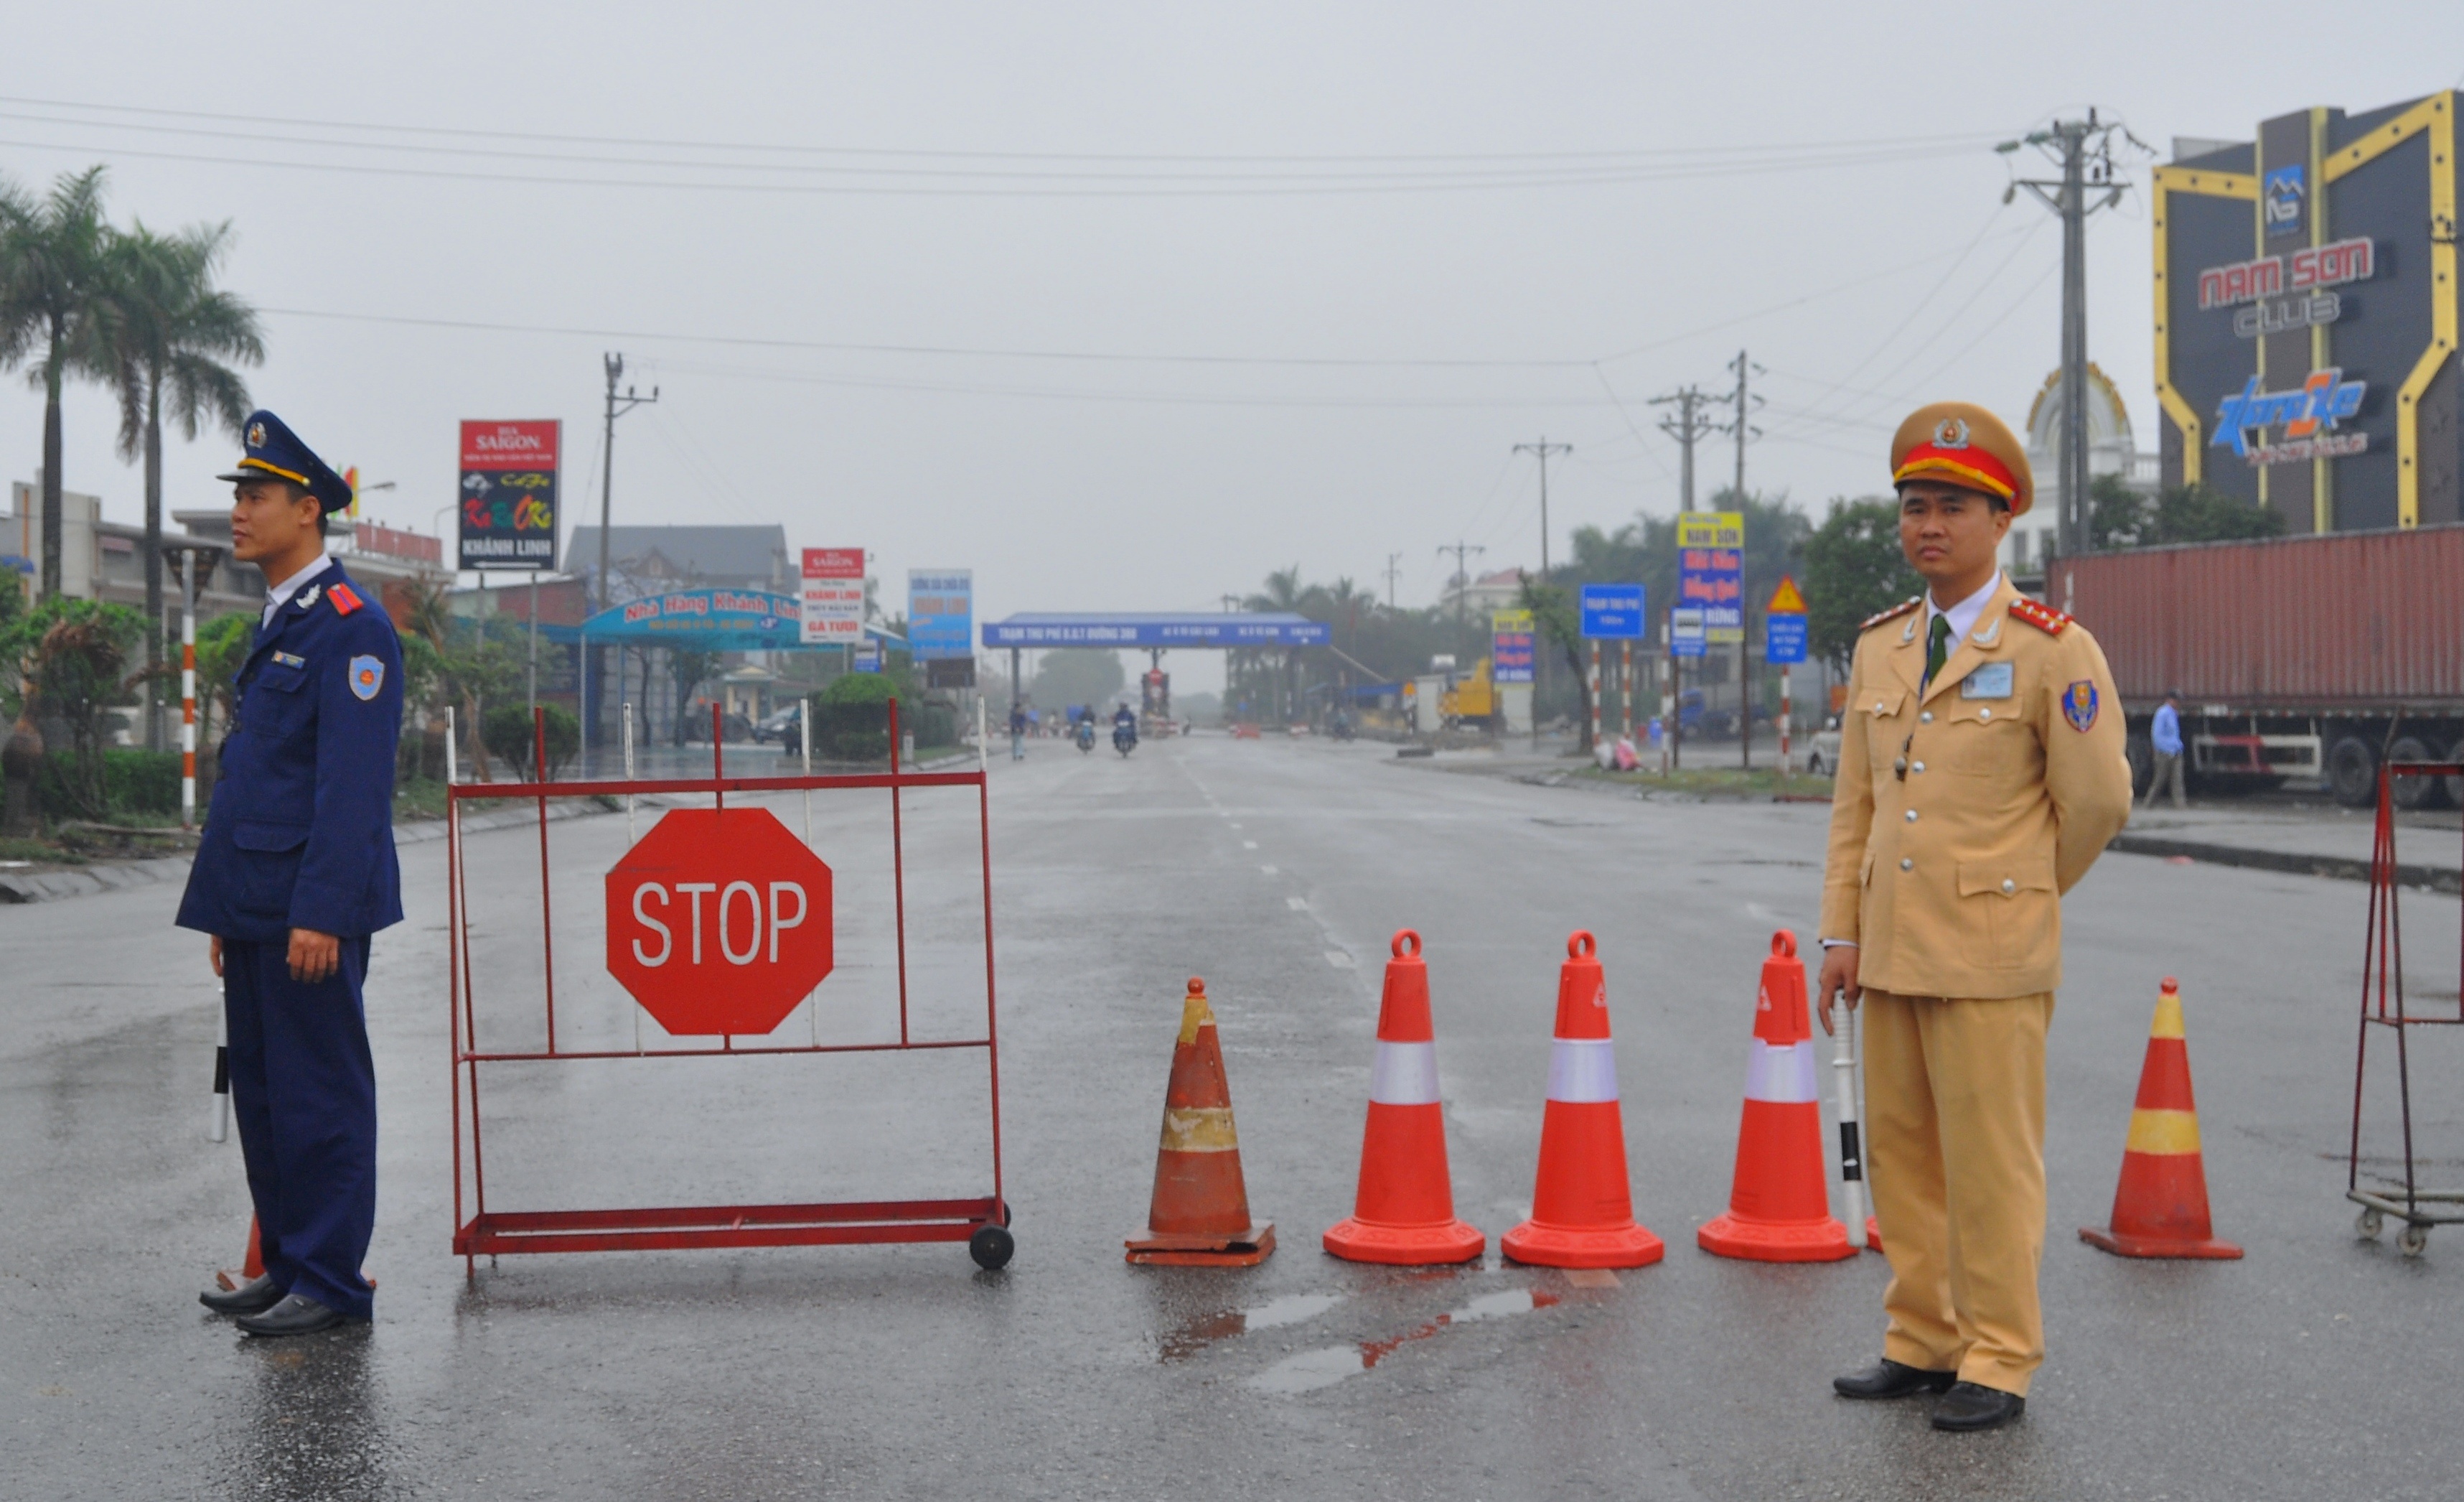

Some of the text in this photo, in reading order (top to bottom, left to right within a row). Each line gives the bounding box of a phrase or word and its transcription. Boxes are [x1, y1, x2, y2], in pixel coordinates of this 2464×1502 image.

[2199, 255, 2282, 311] NAM
[2233, 291, 2341, 339] CLUB
[517, 538, 552, 556] LINH
[632, 880, 807, 968] STOP
